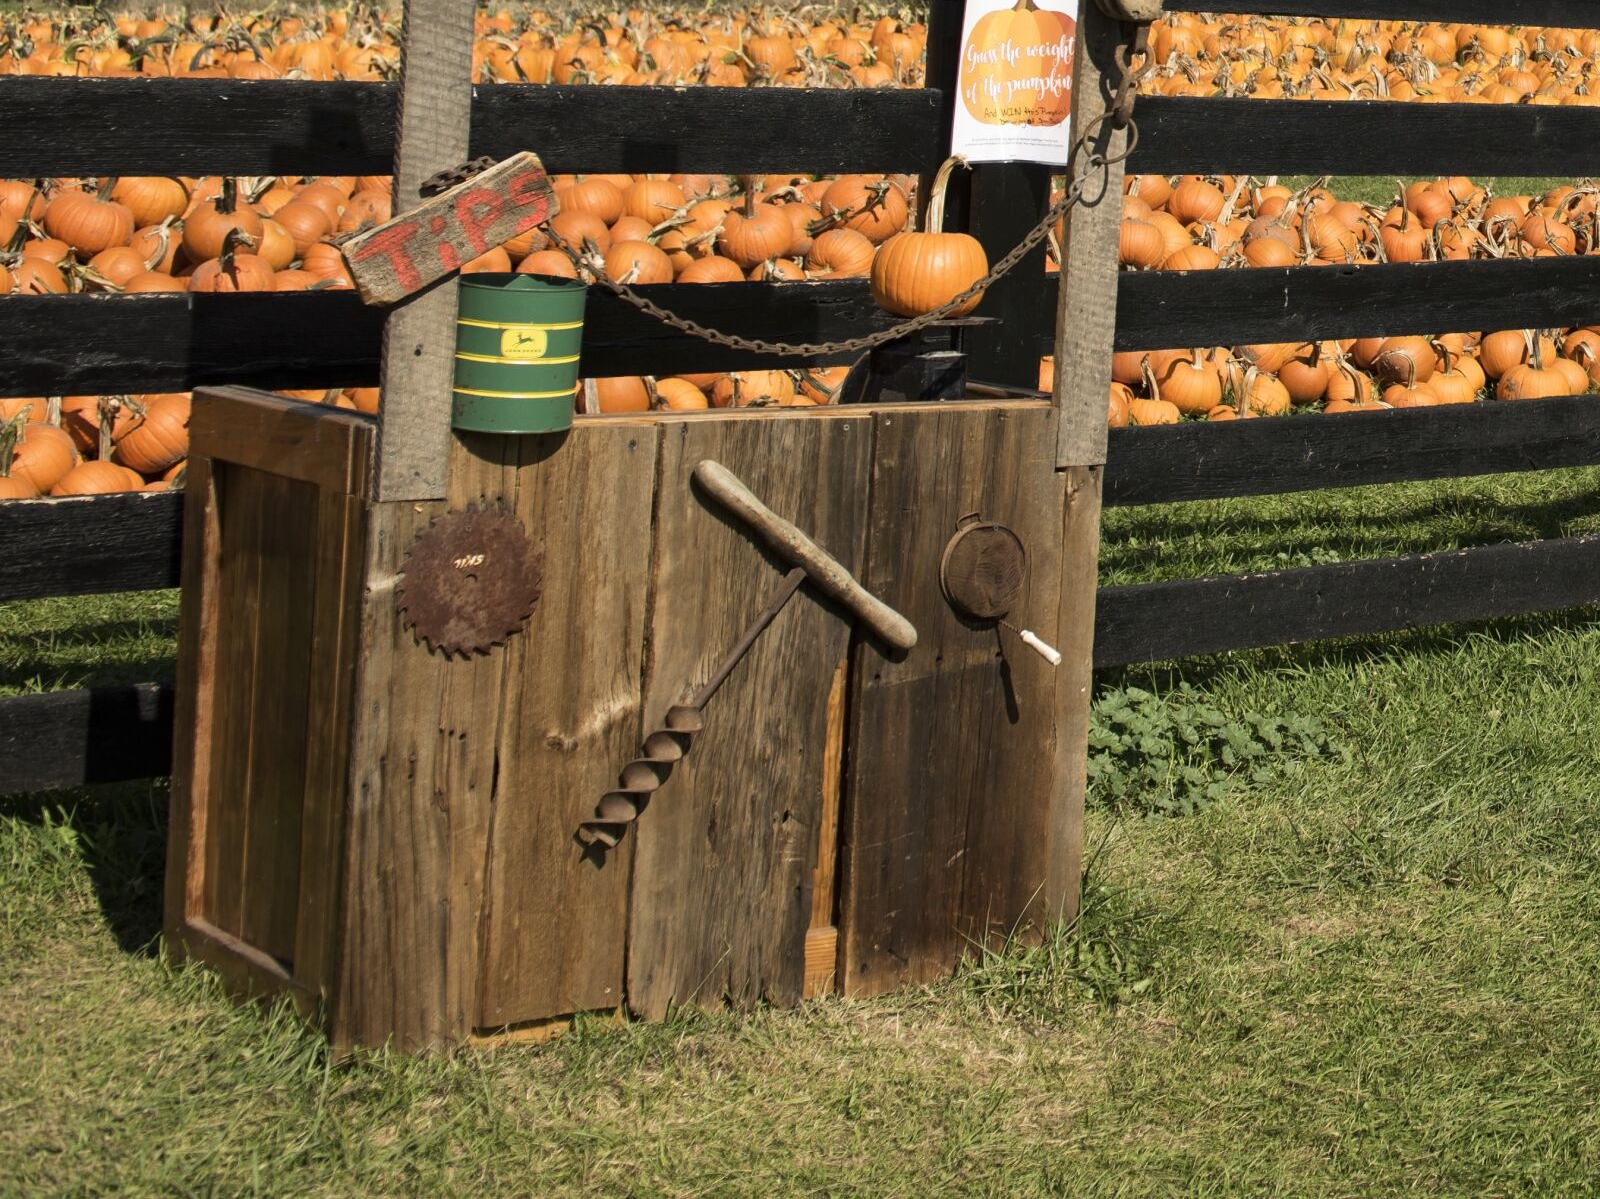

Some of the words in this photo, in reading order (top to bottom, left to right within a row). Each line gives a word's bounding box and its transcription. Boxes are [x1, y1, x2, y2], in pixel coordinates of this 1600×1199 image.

[967, 44, 998, 73] Guess
[1001, 38, 1021, 68] the
[1026, 34, 1075, 67] weight
[966, 81, 977, 105] of
[983, 74, 1002, 103] the
[1005, 67, 1072, 102] pumpkin
[984, 107, 998, 118] And
[1000, 107, 1022, 117] WIN
[452, 553, 483, 569] SKIL
